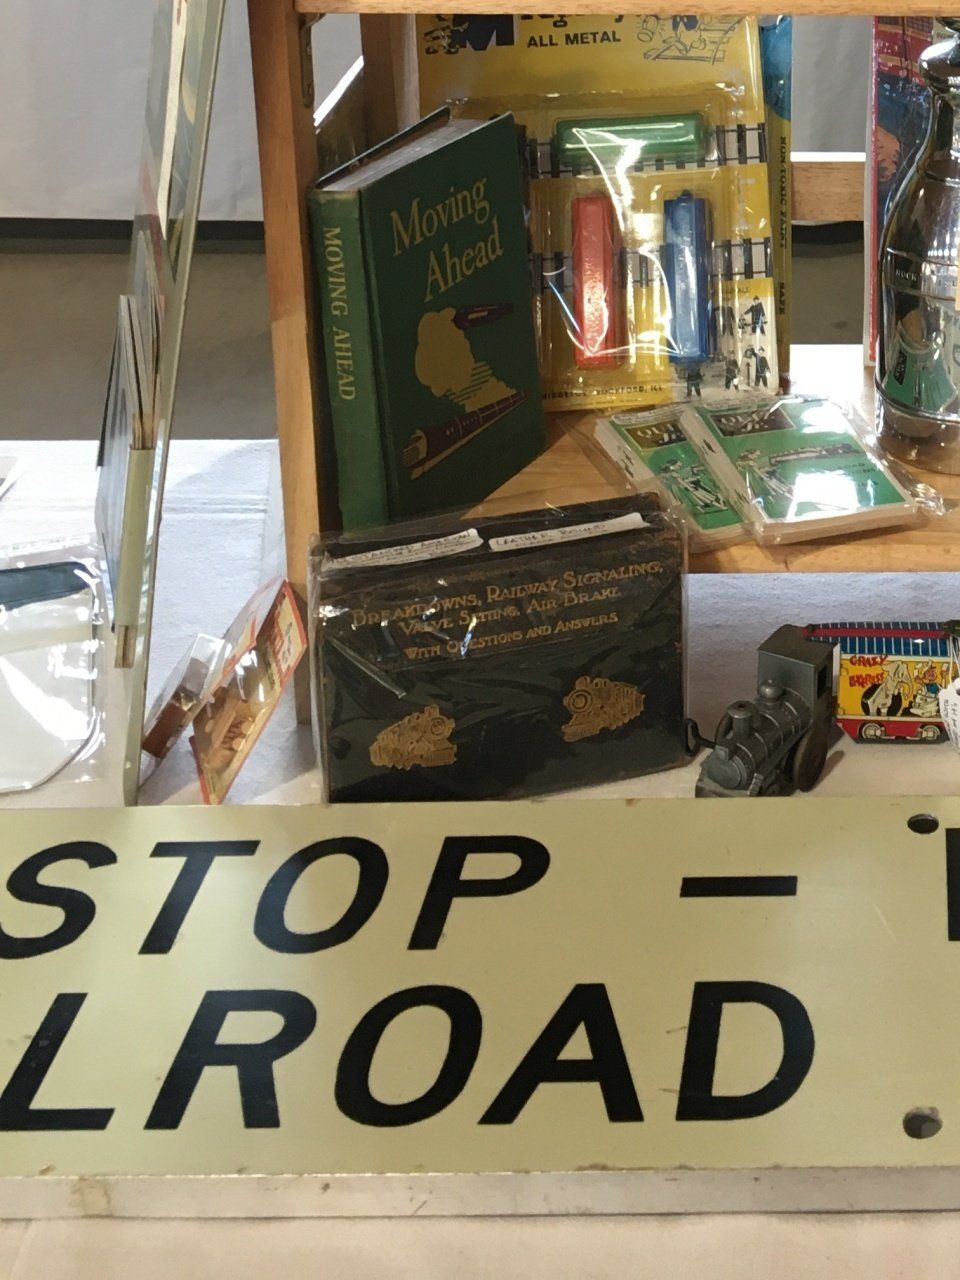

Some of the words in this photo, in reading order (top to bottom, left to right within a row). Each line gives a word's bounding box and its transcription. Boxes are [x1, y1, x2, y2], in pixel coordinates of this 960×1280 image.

[526, 33, 558, 49] ALL
[564, 30, 622, 46] METAL
[389, 177, 491, 257] Moving
[322, 226, 349, 318] MOVING
[423, 214, 505, 303] Ahead
[332, 325, 356, 401] AHEAD
[352, 598, 482, 627] BREAKDOWNS,
[486, 579, 559, 603] RAILWAY
[563, 560, 664, 590] SIGNALING,
[526, 596, 559, 615] AIR
[563, 587, 621, 605] BRAKE
[403, 644, 441, 661] WITH
[525, 627, 551, 640] AND
[555, 612, 619, 634] ANSWERS
[849, 655, 889, 667] CRAZY
[0, 835, 551, 960] STOP
